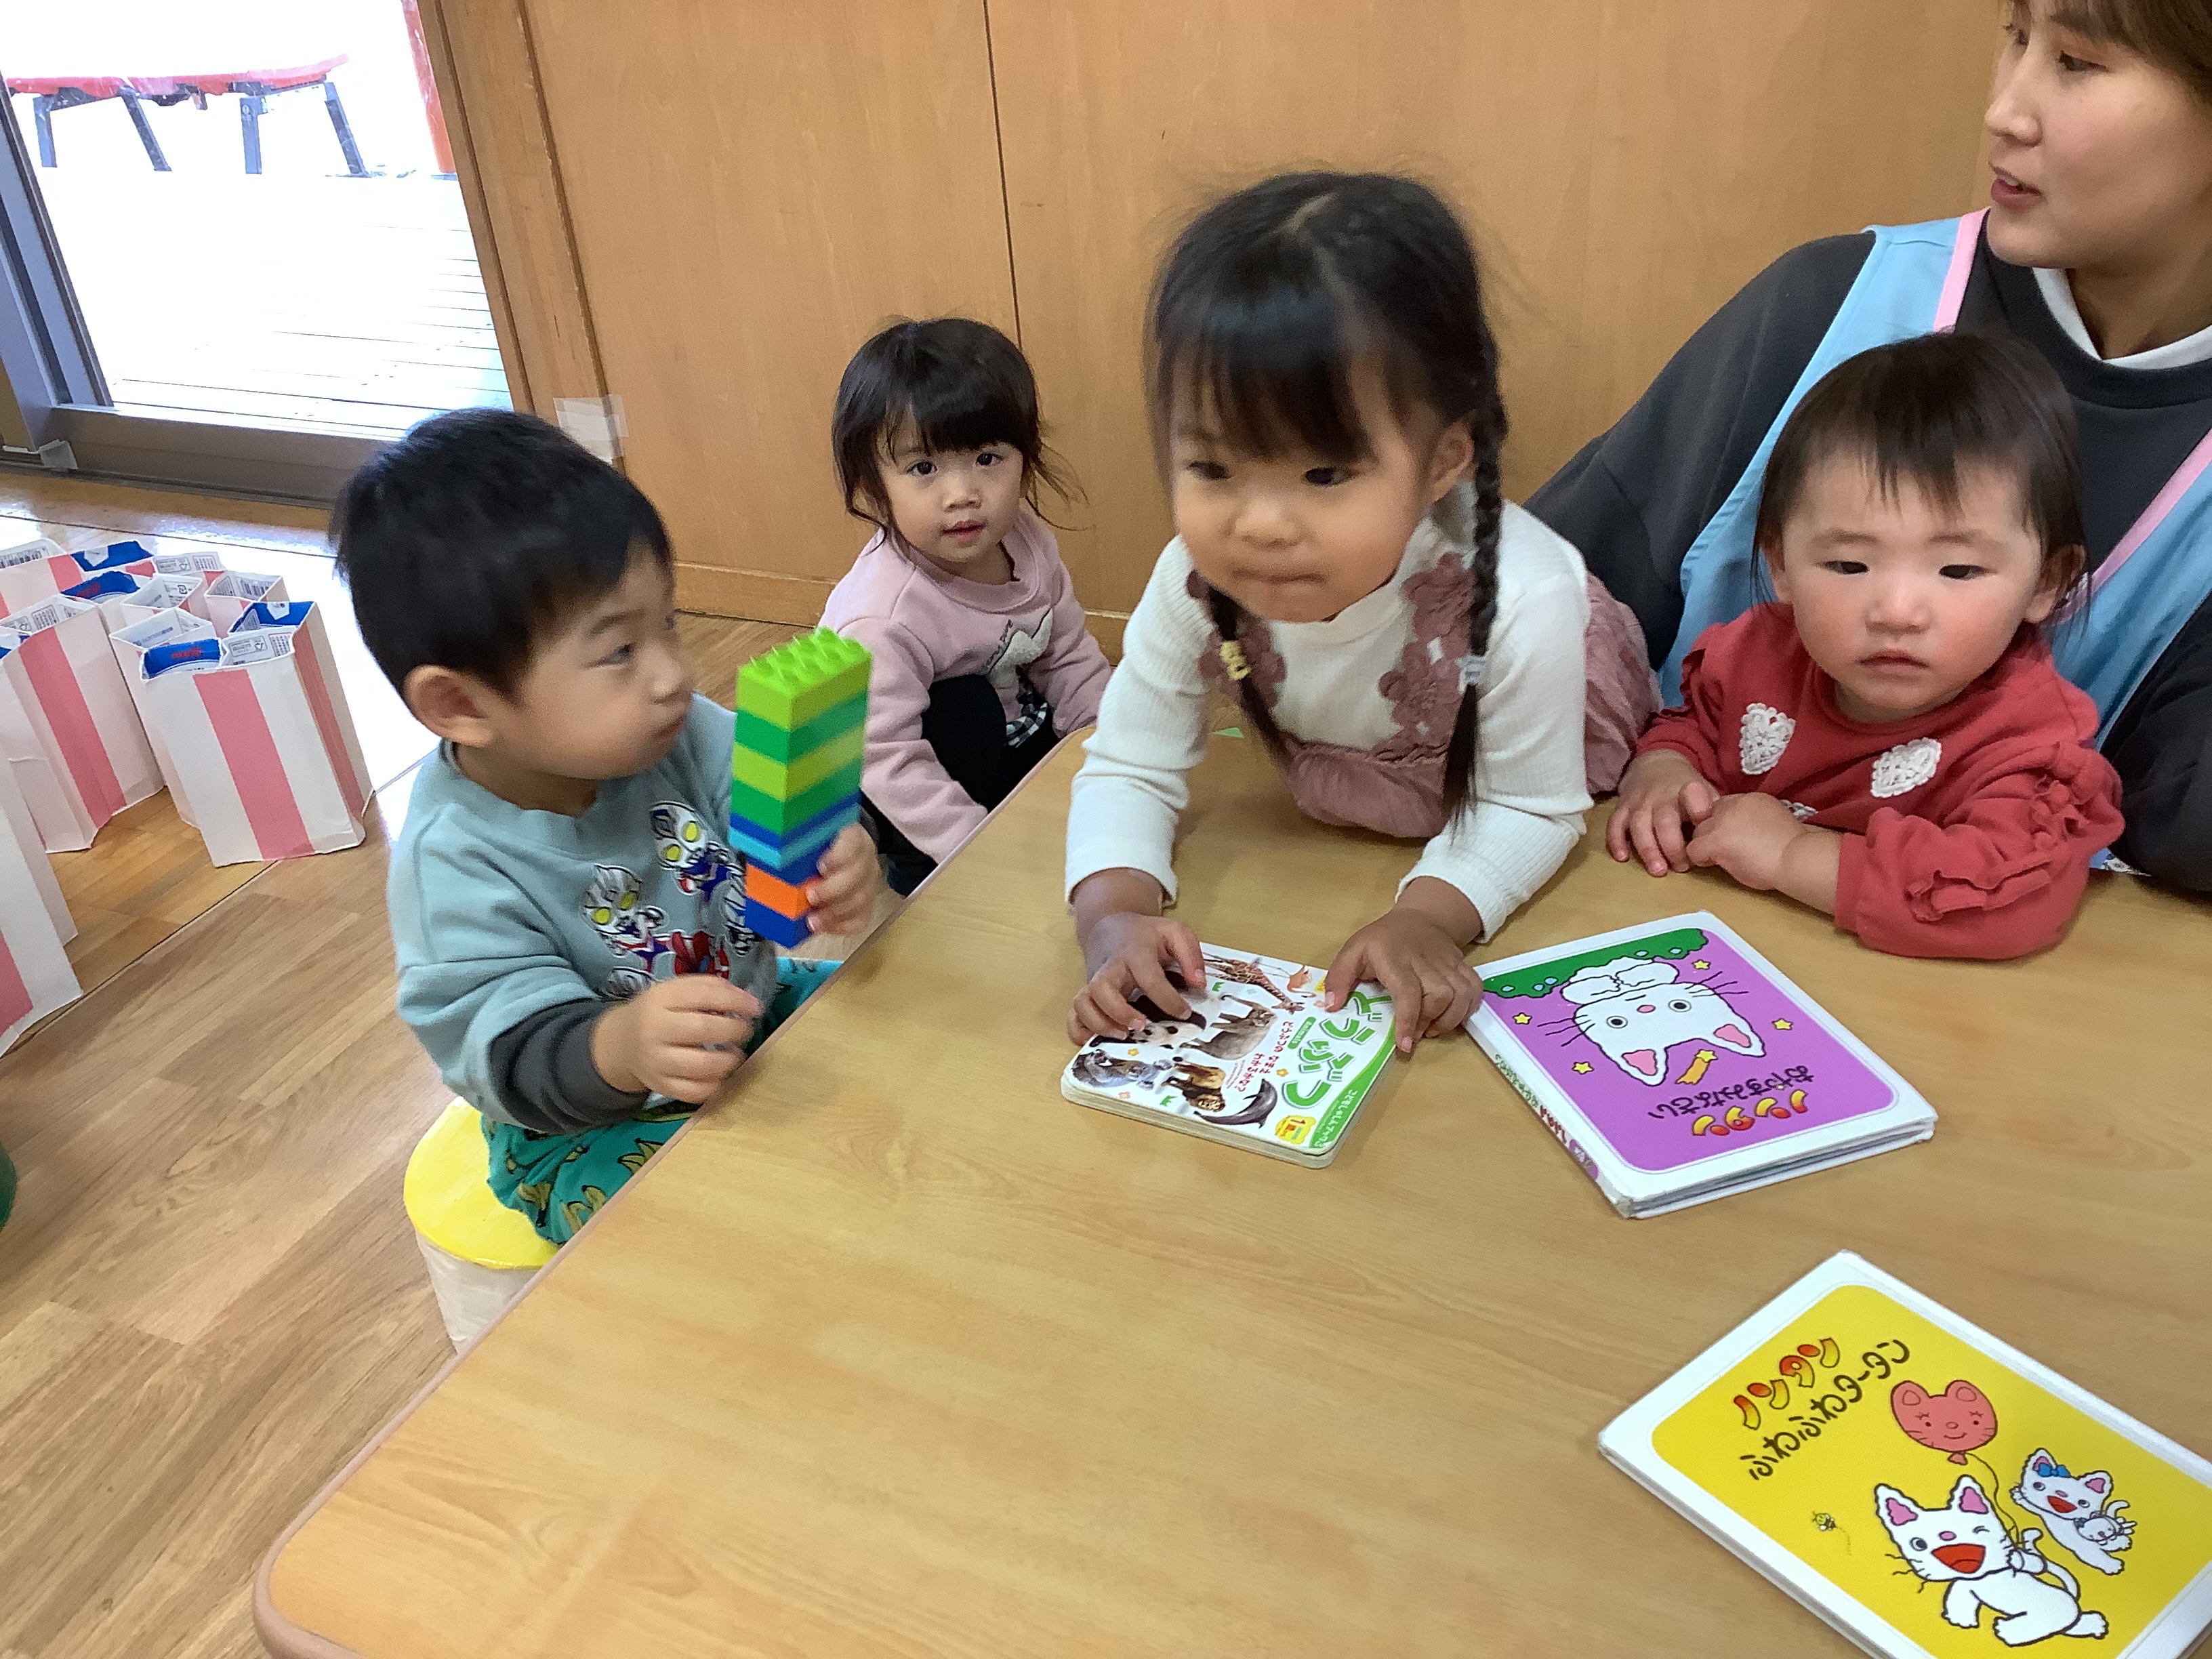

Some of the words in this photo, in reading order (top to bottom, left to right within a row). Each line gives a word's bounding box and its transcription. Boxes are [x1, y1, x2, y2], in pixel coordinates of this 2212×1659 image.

[1282, 990, 1393, 1109] どうぶつ
[1291, 1020, 1312, 1044] Animals
[1647, 1065, 1814, 1119] おやすみなさい
[1692, 1088, 1809, 1136] ノンタン
[1733, 1337, 1841, 1431] ノンタン
[1740, 1339, 1910, 1481] ふわふわタータン
